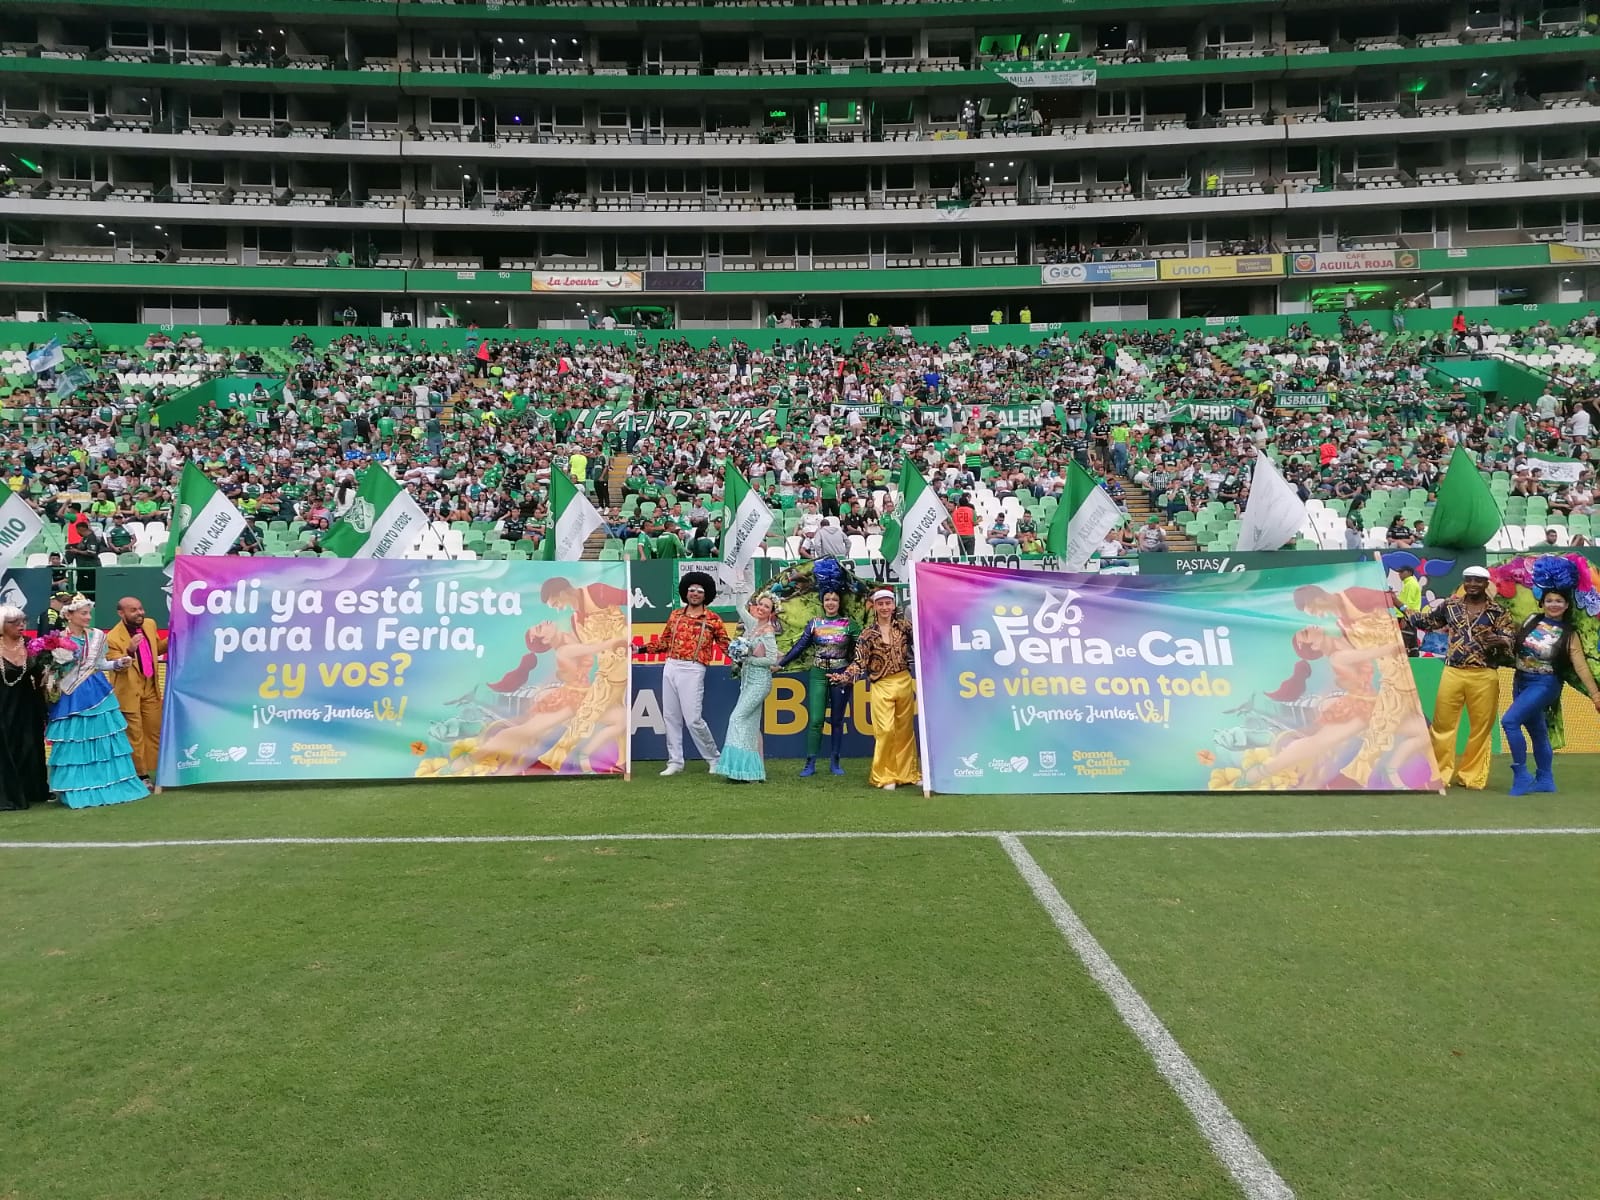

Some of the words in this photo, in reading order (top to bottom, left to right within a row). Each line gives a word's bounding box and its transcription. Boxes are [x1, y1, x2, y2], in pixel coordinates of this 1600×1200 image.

[564, 277, 599, 287] Locura
[1365, 260, 1394, 269] ROJA
[1176, 558, 1219, 570] PASTAS
[181, 580, 262, 616] Cali
[270, 592, 324, 623] ya
[334, 580, 424, 617] está
[435, 581, 522, 615] lista
[213, 628, 315, 663] para
[324, 618, 367, 653] la
[376, 616, 485, 659] Feria,
[951, 624, 991, 651] La
[992, 606, 1114, 666] Feria
[1115, 644, 1137, 658] de
[1138, 626, 1233, 666] Cali
[258, 667, 307, 699] ¿y
[318, 652, 412, 688] vos?
[959, 672, 995, 698] Se
[1003, 668, 1088, 696] viene
[1095, 677, 1150, 696] con
[1157, 671, 1232, 697] todo
